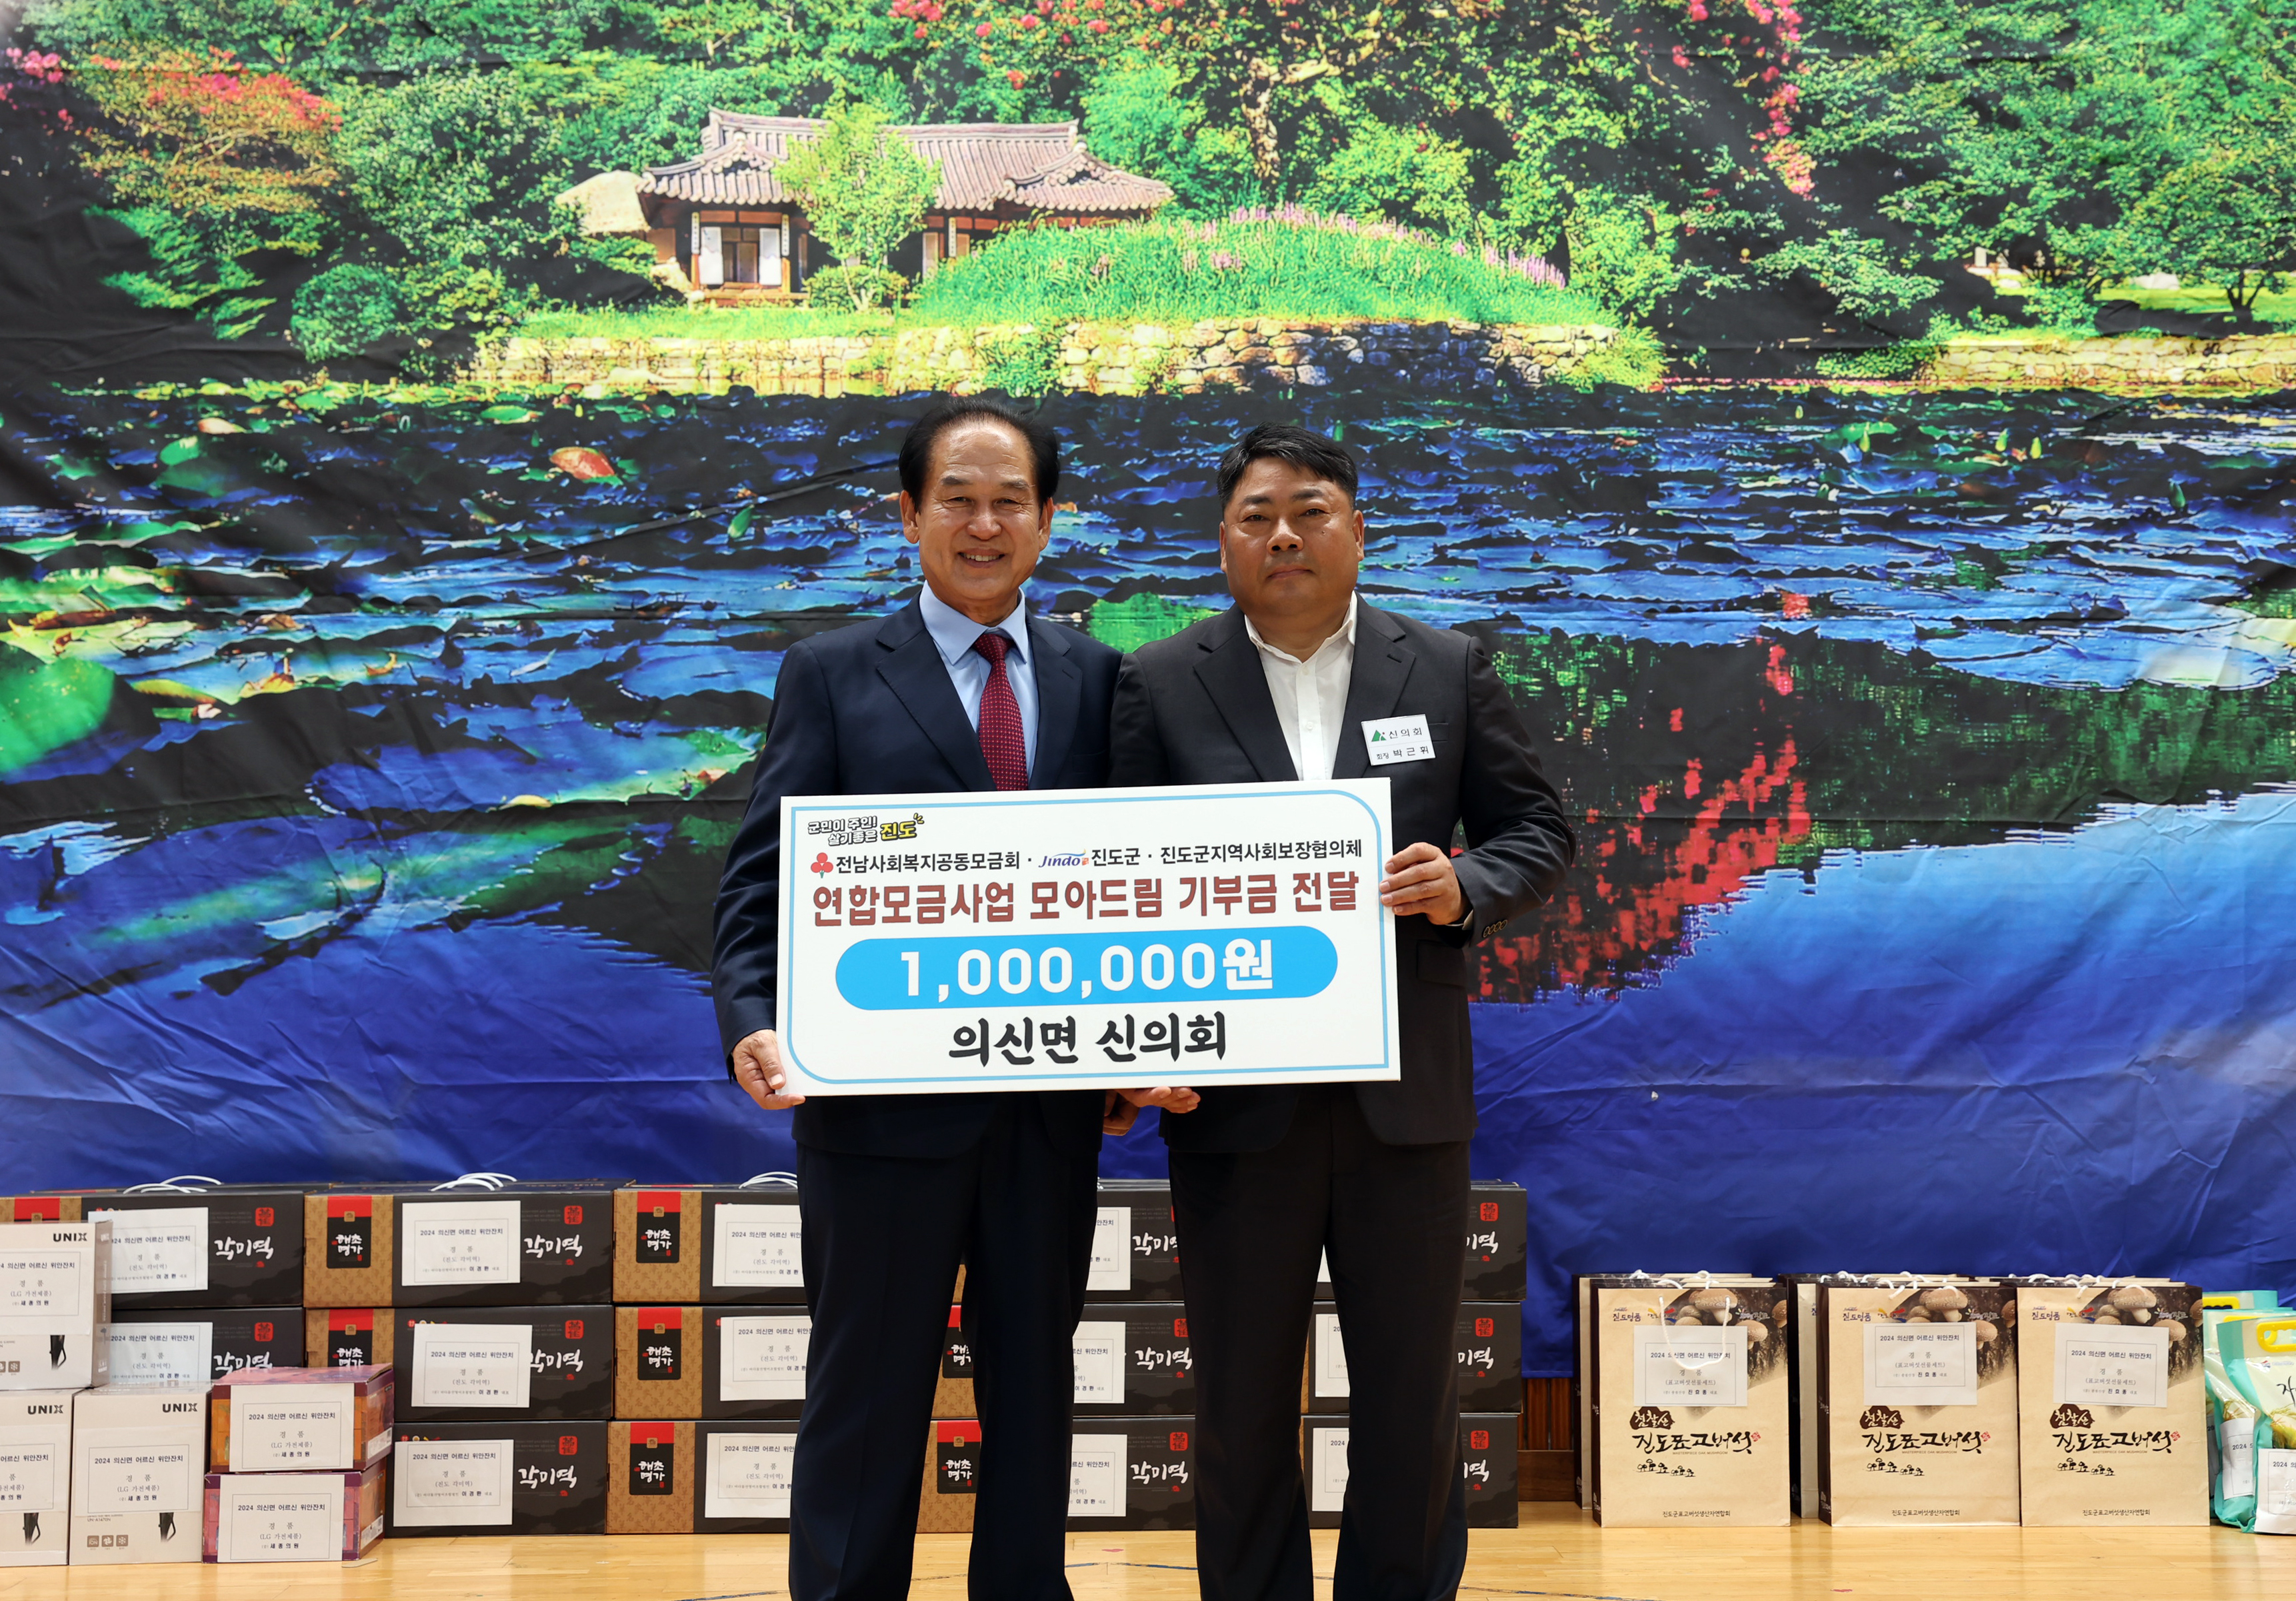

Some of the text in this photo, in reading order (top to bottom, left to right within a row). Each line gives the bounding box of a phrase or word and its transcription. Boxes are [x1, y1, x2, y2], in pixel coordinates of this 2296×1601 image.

[1389, 727, 1422, 739] 신의회
[808, 816, 877, 834] 군민이 주인!
[826, 820, 917, 846] 살기좋은 진도
[836, 839, 1361, 873] 전남사회복지공동모금회 Jindo 진도군 진도군지역사회보장협의체
[813, 869, 1361, 926] 연합모금사업 모아드림 기부금 전달
[900, 937, 1273, 1002] 1,000,000원
[949, 1011, 1225, 1067] 의신면 신의회
[53, 1233, 87, 1242] UNIX
[336, 1234, 362, 1244] 해초
[645, 1229, 671, 1239] 해초
[524, 1234, 583, 1258] 각미역
[647, 1240, 671, 1251] 명가
[1467, 1230, 1499, 1253] 미역
[214, 1236, 273, 1260] 각미역
[338, 1244, 363, 1256] 명가
[1613, 1313, 1641, 1322] 진도명품
[1843, 1312, 1871, 1321] 진도명품
[2032, 1312, 2060, 1320] 진도명품
[337, 1347, 363, 1357] 해초
[647, 1346, 672, 1356] 해초
[649, 1356, 673, 1368] 명가
[1135, 1346, 1192, 1370] 각미역
[1457, 1346, 1493, 1369] 미역
[28, 1405, 63, 1414] UNIX
[163, 1403, 197, 1412] UNIX
[1632, 1432, 1752, 1454] 진도표고버섯
[1861, 1432, 1981, 1454] 진도표고버섯
[2052, 1431, 2172, 1454] 진도표고버섯
[639, 1460, 664, 1470] 해초
[946, 1459, 971, 1469] 해초
[518, 1465, 577, 1489] 각미역
[641, 1471, 665, 1482] 명가
[948, 1470, 972, 1481] 명가
[1131, 1461, 1188, 1484] 각미역
